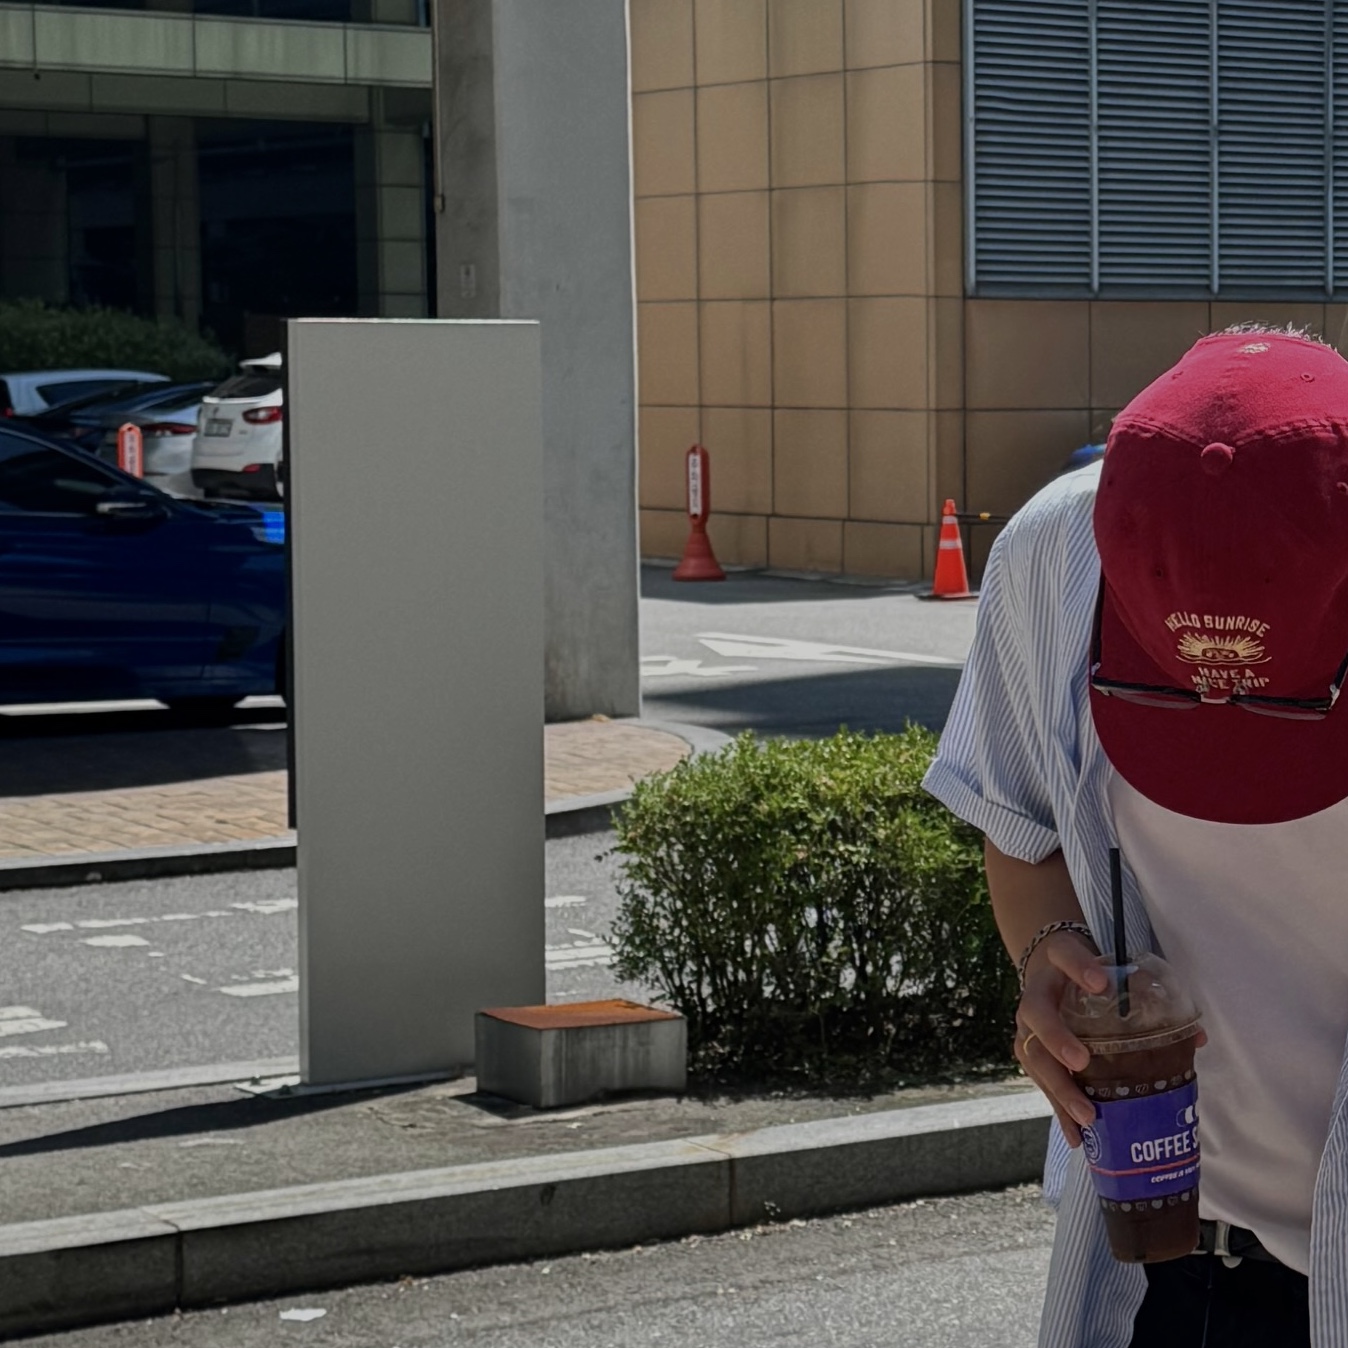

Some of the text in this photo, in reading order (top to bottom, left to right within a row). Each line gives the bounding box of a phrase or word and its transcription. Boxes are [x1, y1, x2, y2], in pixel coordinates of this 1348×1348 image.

[1164, 611, 1271, 638] HELLO SUNRISE
[1198, 666, 1255, 679] HAVE A
[1130, 1130, 1191, 1163] COFFEE
